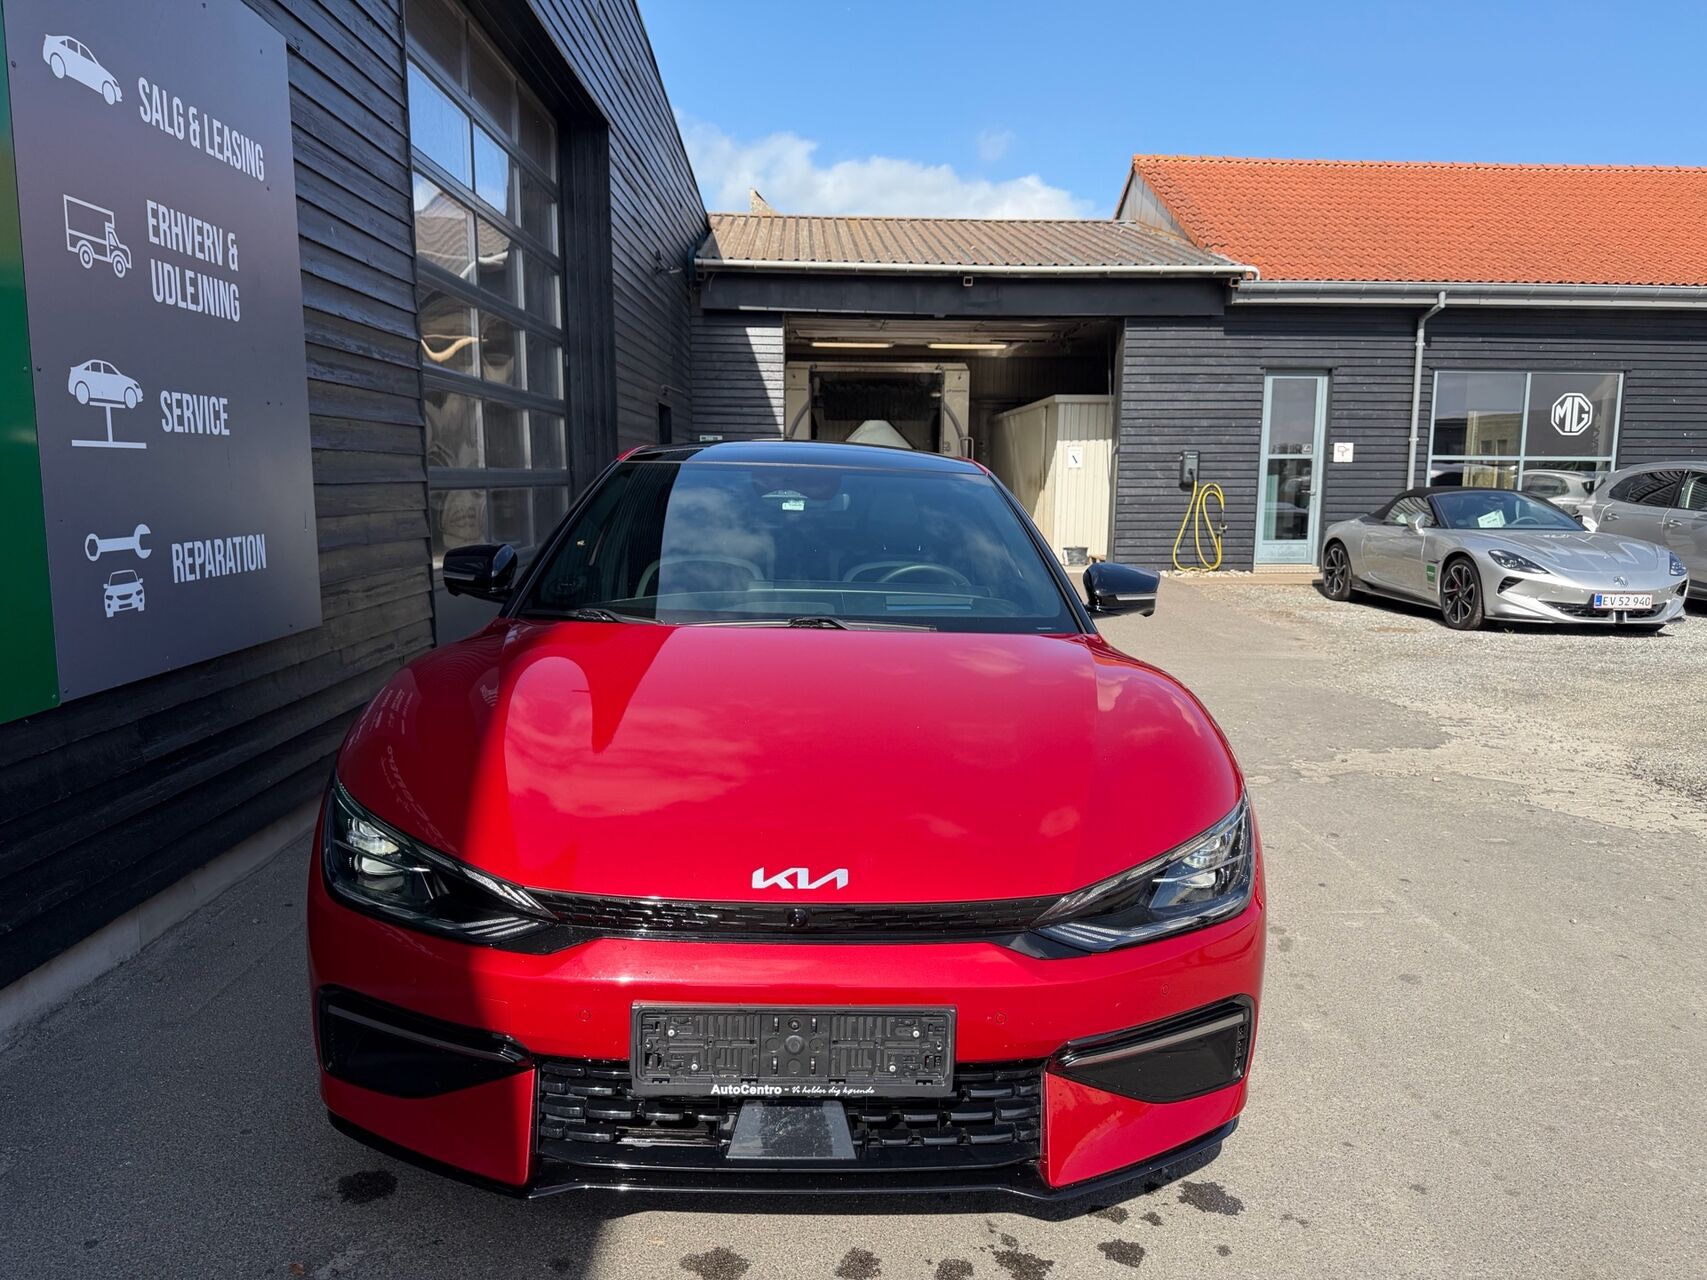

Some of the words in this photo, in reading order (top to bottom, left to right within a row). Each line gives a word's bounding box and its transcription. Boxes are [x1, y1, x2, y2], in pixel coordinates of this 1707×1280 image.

[138, 76, 185, 140] SALG
[188, 105, 200, 149] &
[203, 113, 265, 182] LEASING
[146, 199, 223, 266] ERHVERV
[227, 232, 239, 272] &
[150, 258, 241, 323] UDLEJNING
[160, 390, 230, 435] SERVICE
[1554, 396, 1590, 432] MG
[171, 533, 267, 584] REPARATION
[1602, 596, 1617, 606] EV
[1618, 596, 1631, 606] 52
[1633, 596, 1651, 606] 940
[751, 867, 849, 890] KIA
[710, 1084, 782, 1095] AutoCentro
[791, 1085, 801, 1094] Vi
[801, 1085, 827, 1094] holder
[828, 1085, 841, 1097] dig
